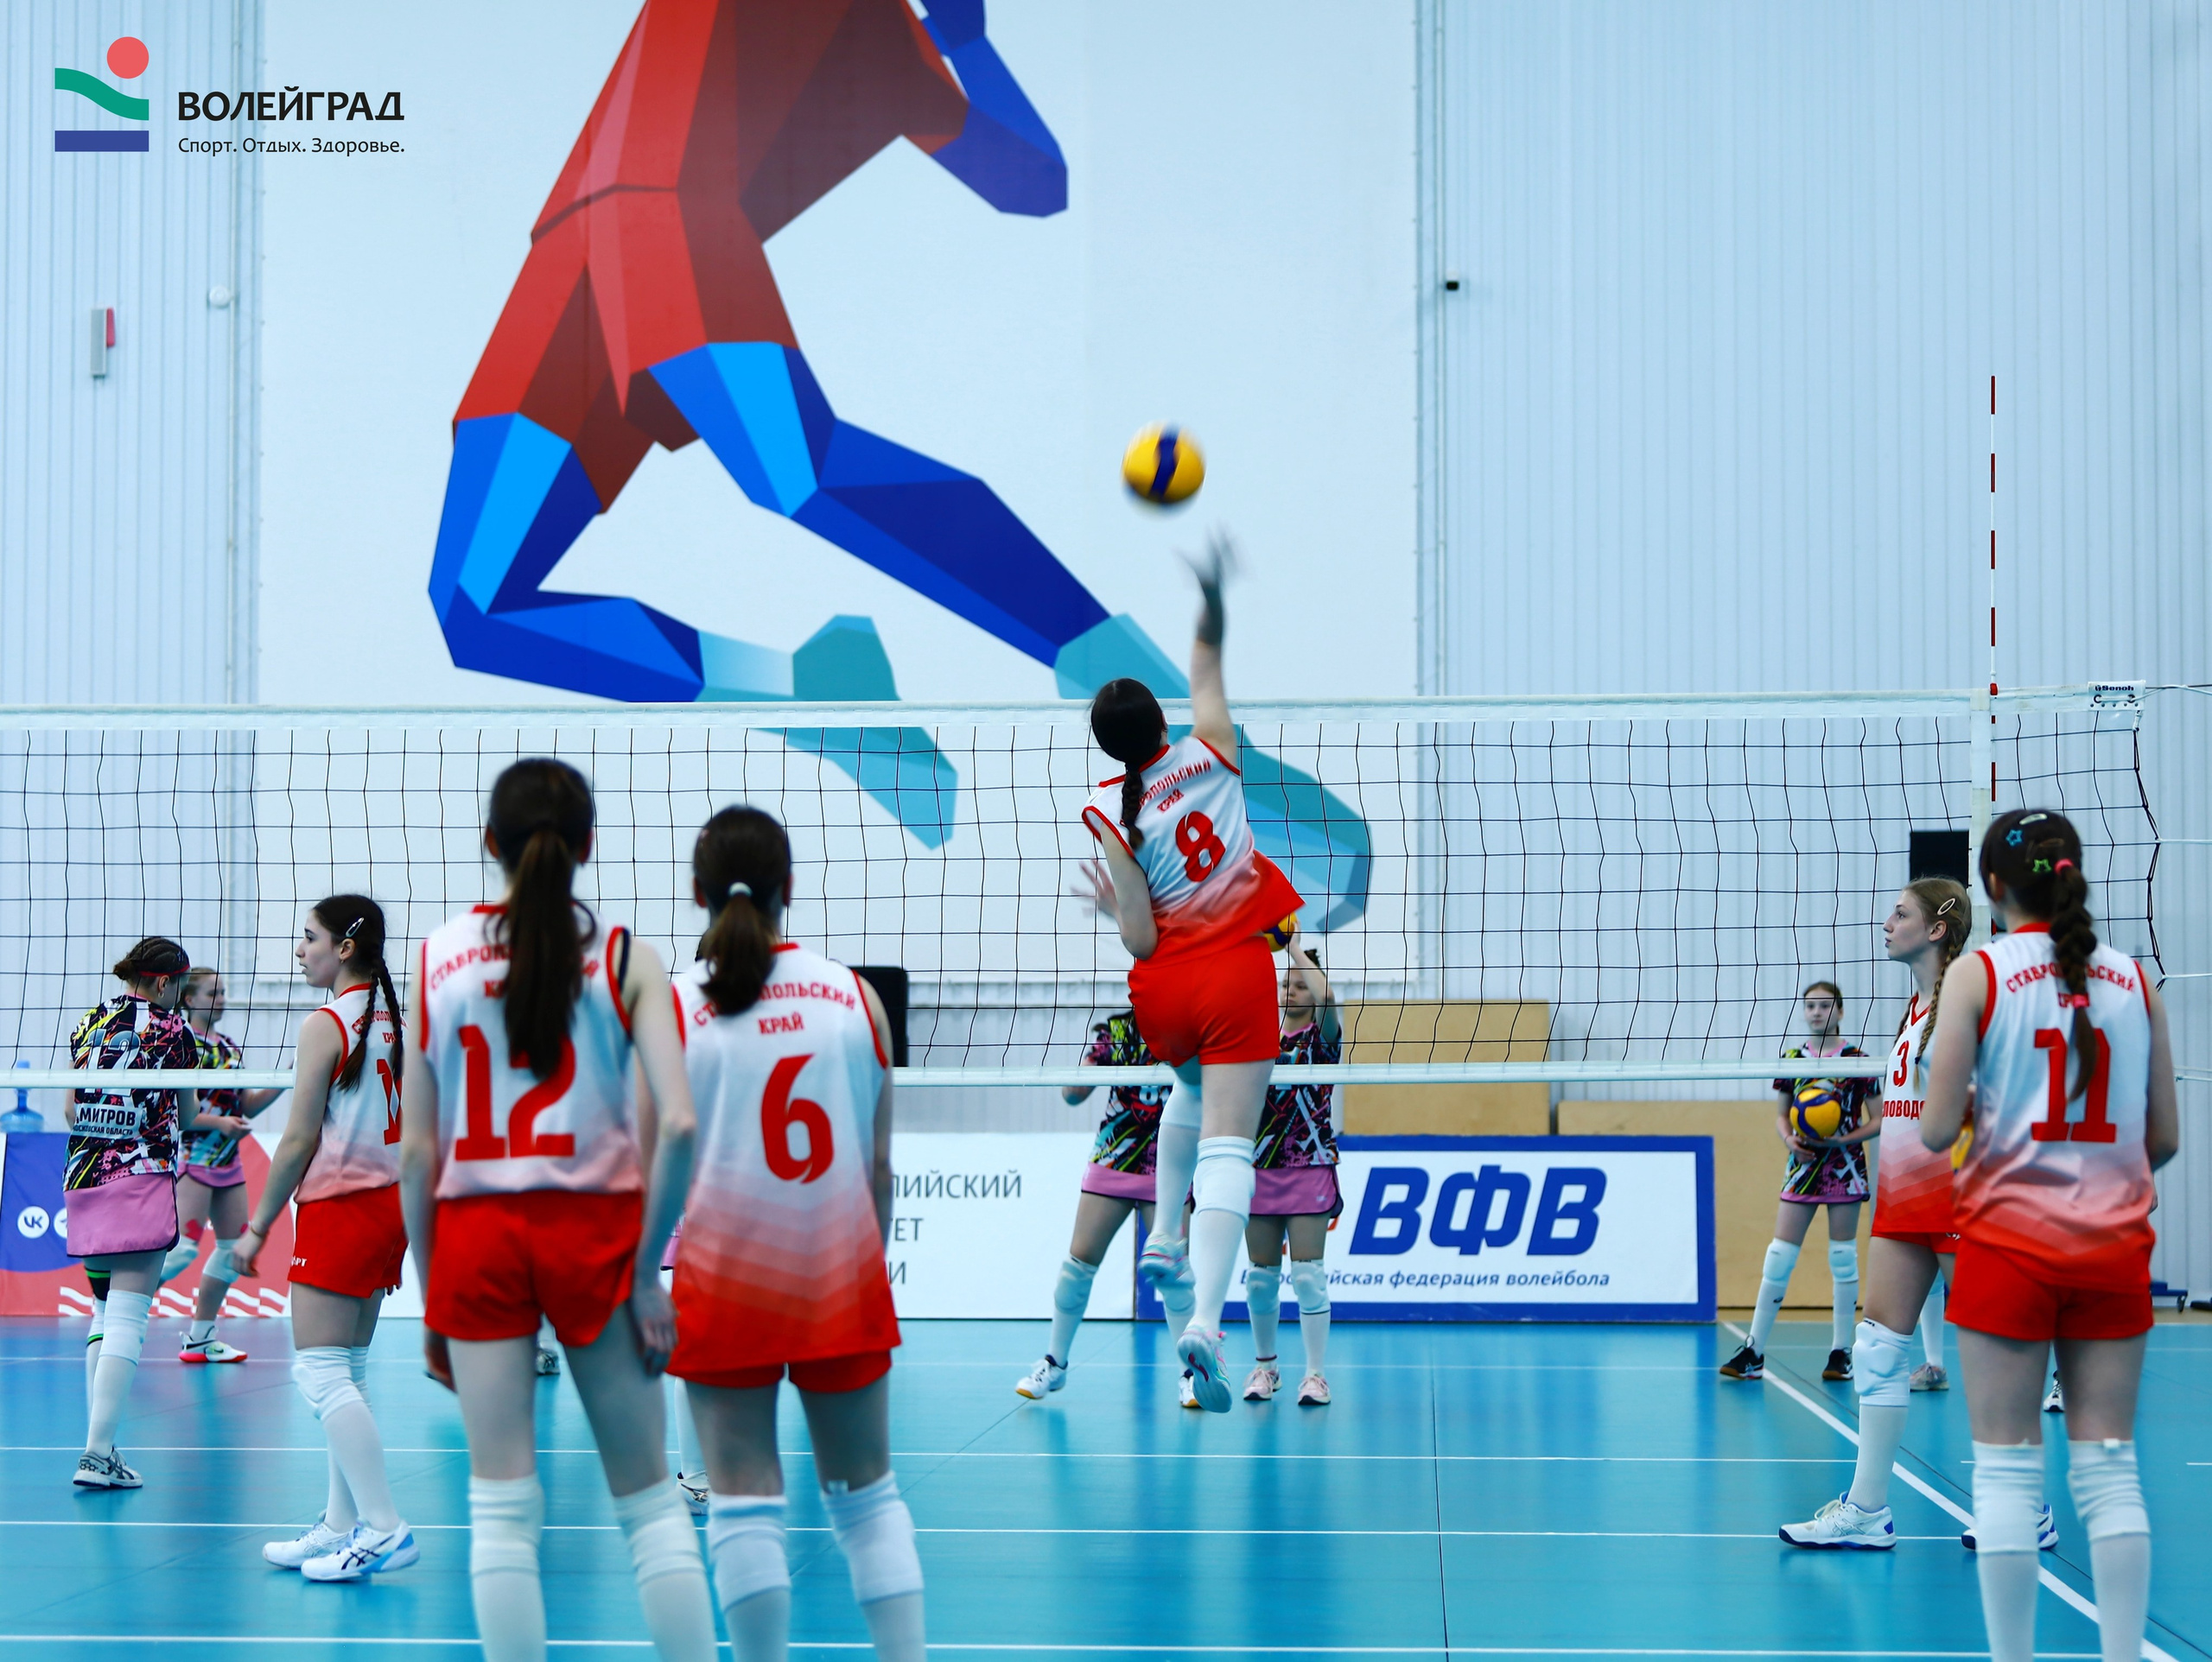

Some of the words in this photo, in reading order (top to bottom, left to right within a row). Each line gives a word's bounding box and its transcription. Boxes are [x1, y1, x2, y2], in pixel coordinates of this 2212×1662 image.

[1175, 810, 1226, 883] 8
[758, 1011, 804, 1034] КРАЙ
[454, 1024, 575, 1161] 12
[1893, 1040, 1910, 1088] 3
[2031, 1028, 2117, 1143] 11
[76, 1107, 136, 1126] МИТРОВ
[760, 1053, 835, 1184] 6
[1349, 1164, 1607, 1256] ВФВ
[1389, 1270, 1499, 1289] федерация
[1506, 1270, 1611, 1286] волейбола
